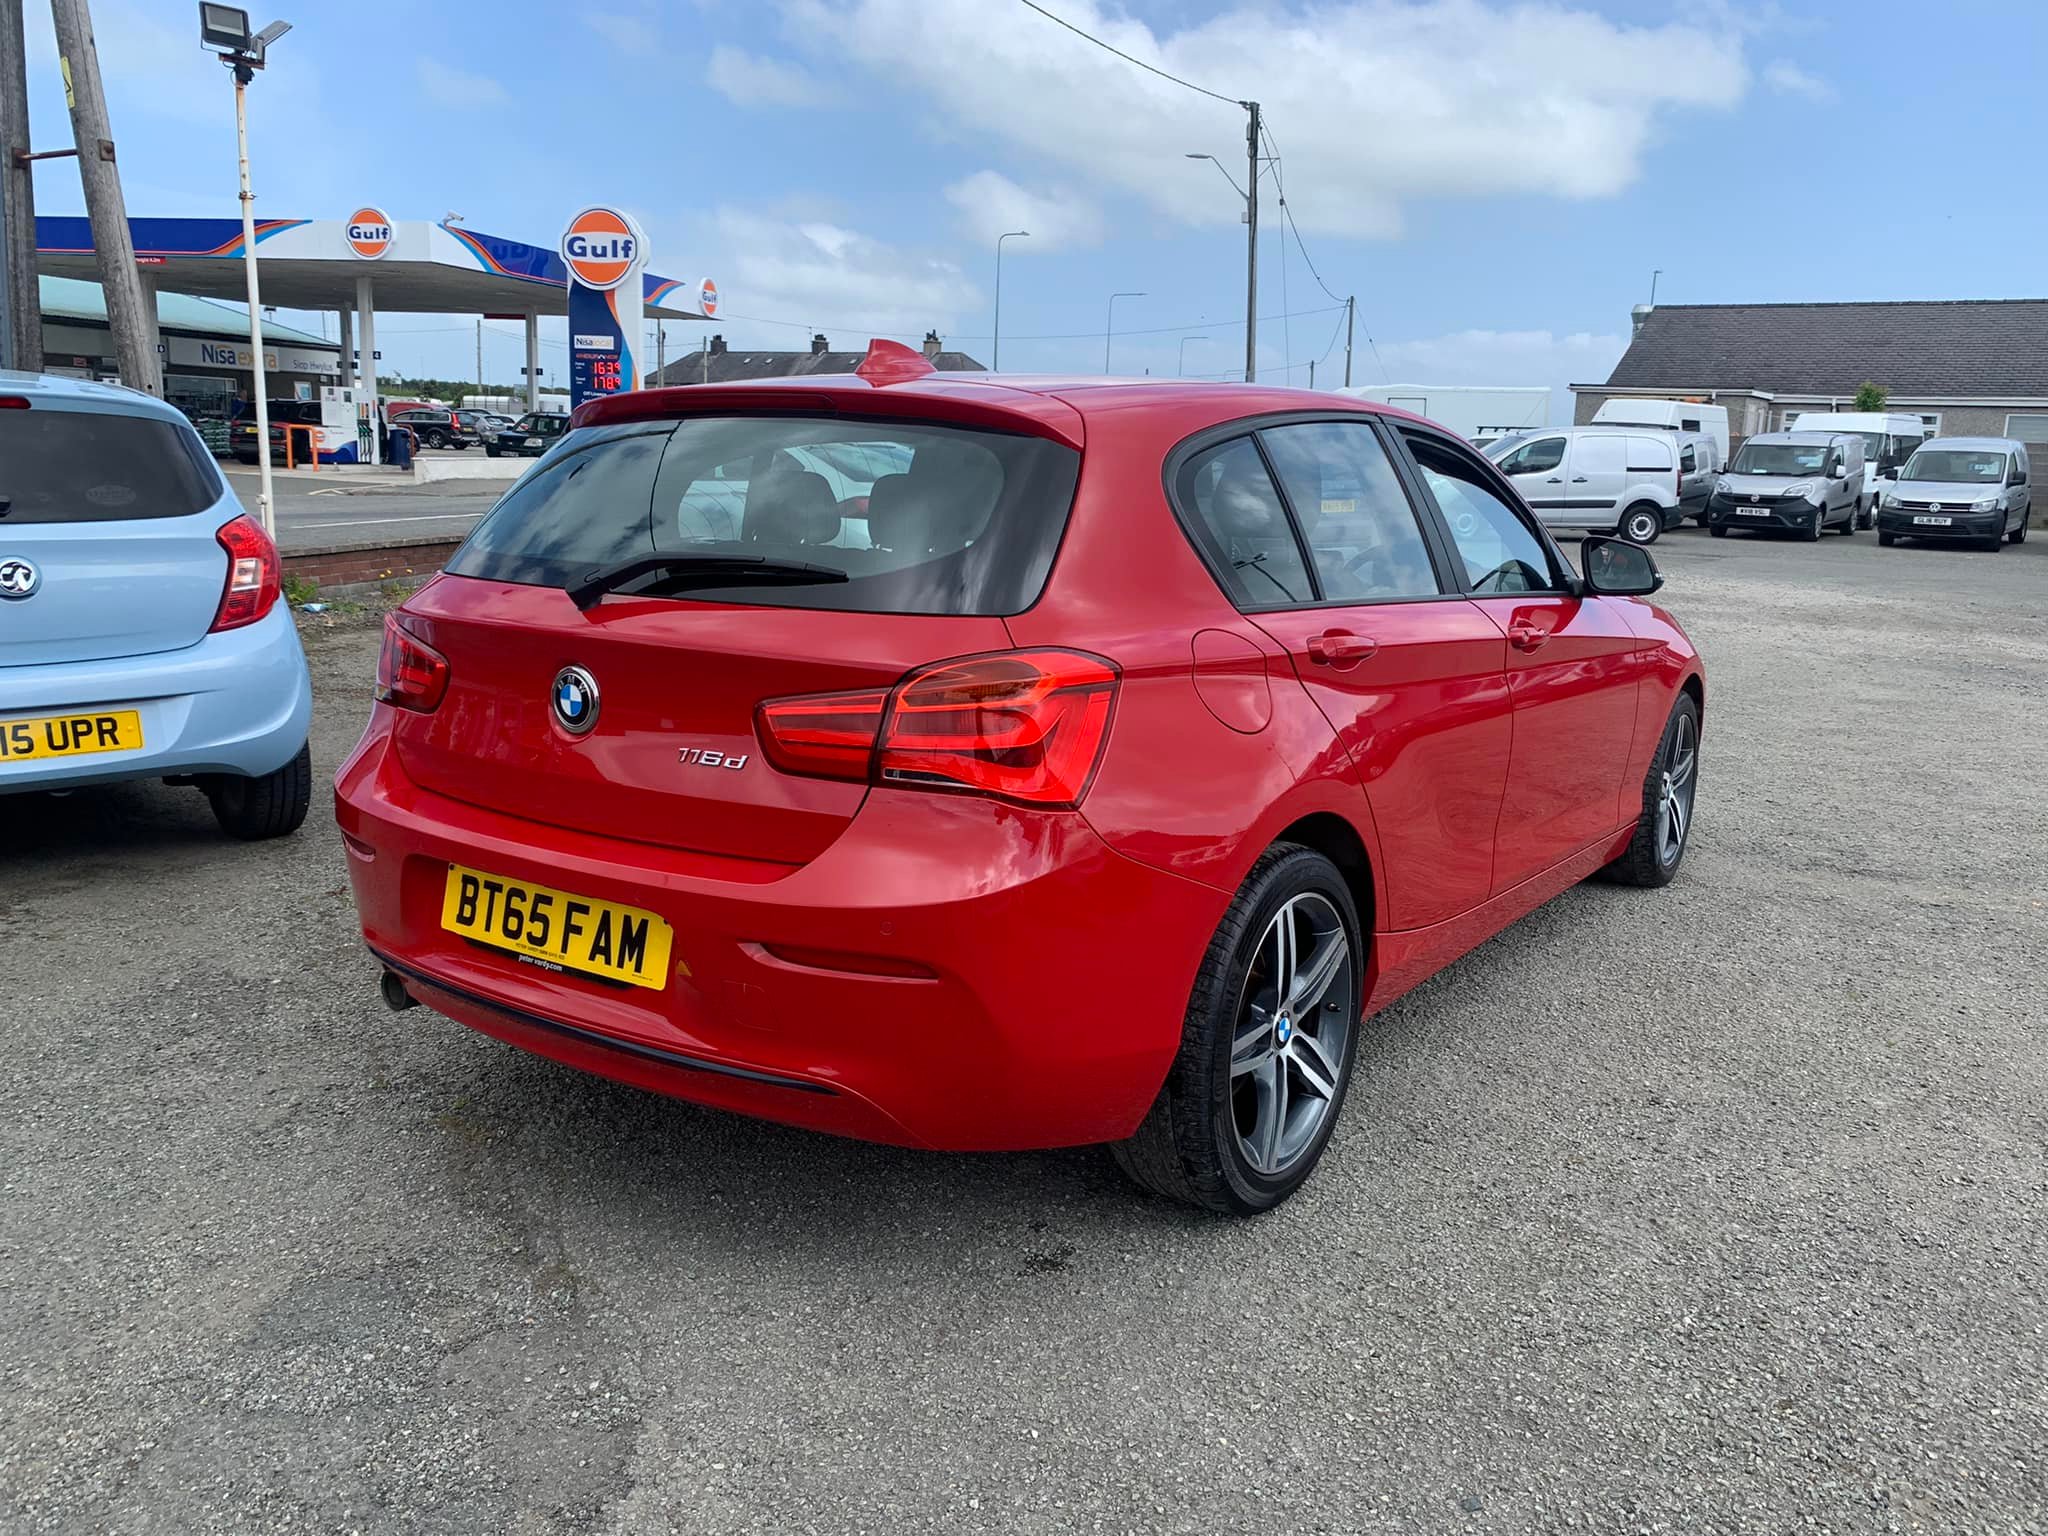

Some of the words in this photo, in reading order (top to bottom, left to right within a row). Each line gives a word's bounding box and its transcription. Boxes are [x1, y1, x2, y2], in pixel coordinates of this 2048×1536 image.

[349, 225, 389, 240] Gulf
[567, 236, 633, 258] Gulf
[703, 290, 718, 303] Gulf
[575, 337, 592, 346] Nisa
[201, 343, 237, 366] Nisa
[237, 350, 277, 369] exra
[557, 675, 588, 693] BMW
[45, 717, 121, 751] UPR
[679, 747, 748, 770] 116d
[456, 873, 554, 948] BT65
[560, 901, 649, 974] FAM
